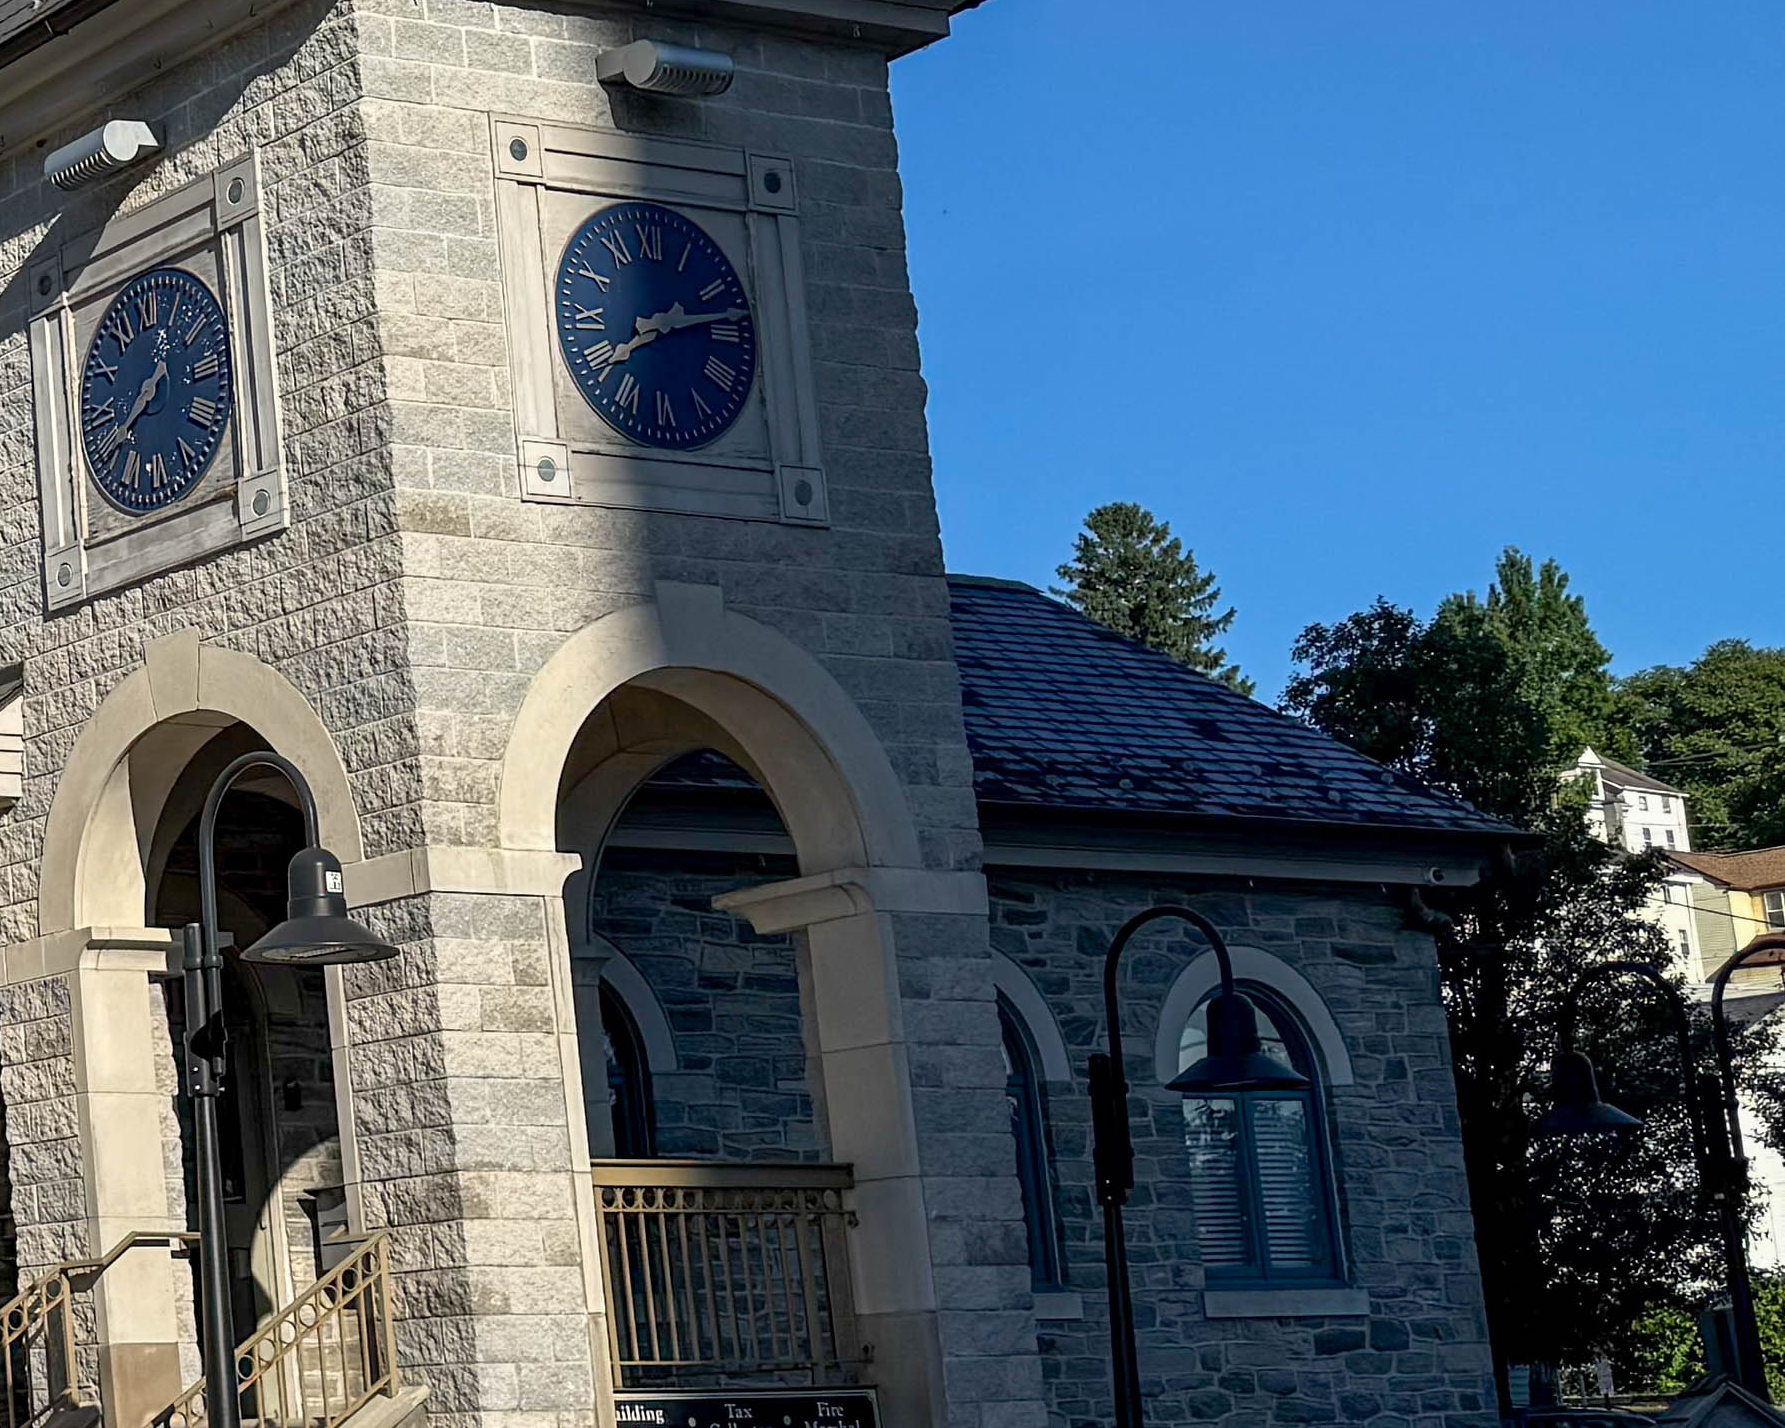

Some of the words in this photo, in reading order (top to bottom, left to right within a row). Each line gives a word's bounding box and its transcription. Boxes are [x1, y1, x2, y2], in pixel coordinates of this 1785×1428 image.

[601, 229, 632, 269] XI
[636, 224, 662, 260] XII
[579, 260, 611, 292] X
[699, 278, 725, 301] II
[137, 289, 157, 331] XII
[574, 303, 605, 329] IX
[112, 311, 134, 352] XI
[185, 314, 207, 345] II
[711, 324, 739, 342] III
[94, 356, 118, 382] X
[194, 354, 218, 378] III
[92, 396, 114, 426] IX
[656, 390, 676, 427] VI
[691, 387, 711, 419] V
[178, 437, 195, 465] V
[153, 453, 168, 487] VI
[724, 1403, 753, 1419] Tax
[816, 1401, 845, 1418] Fire
